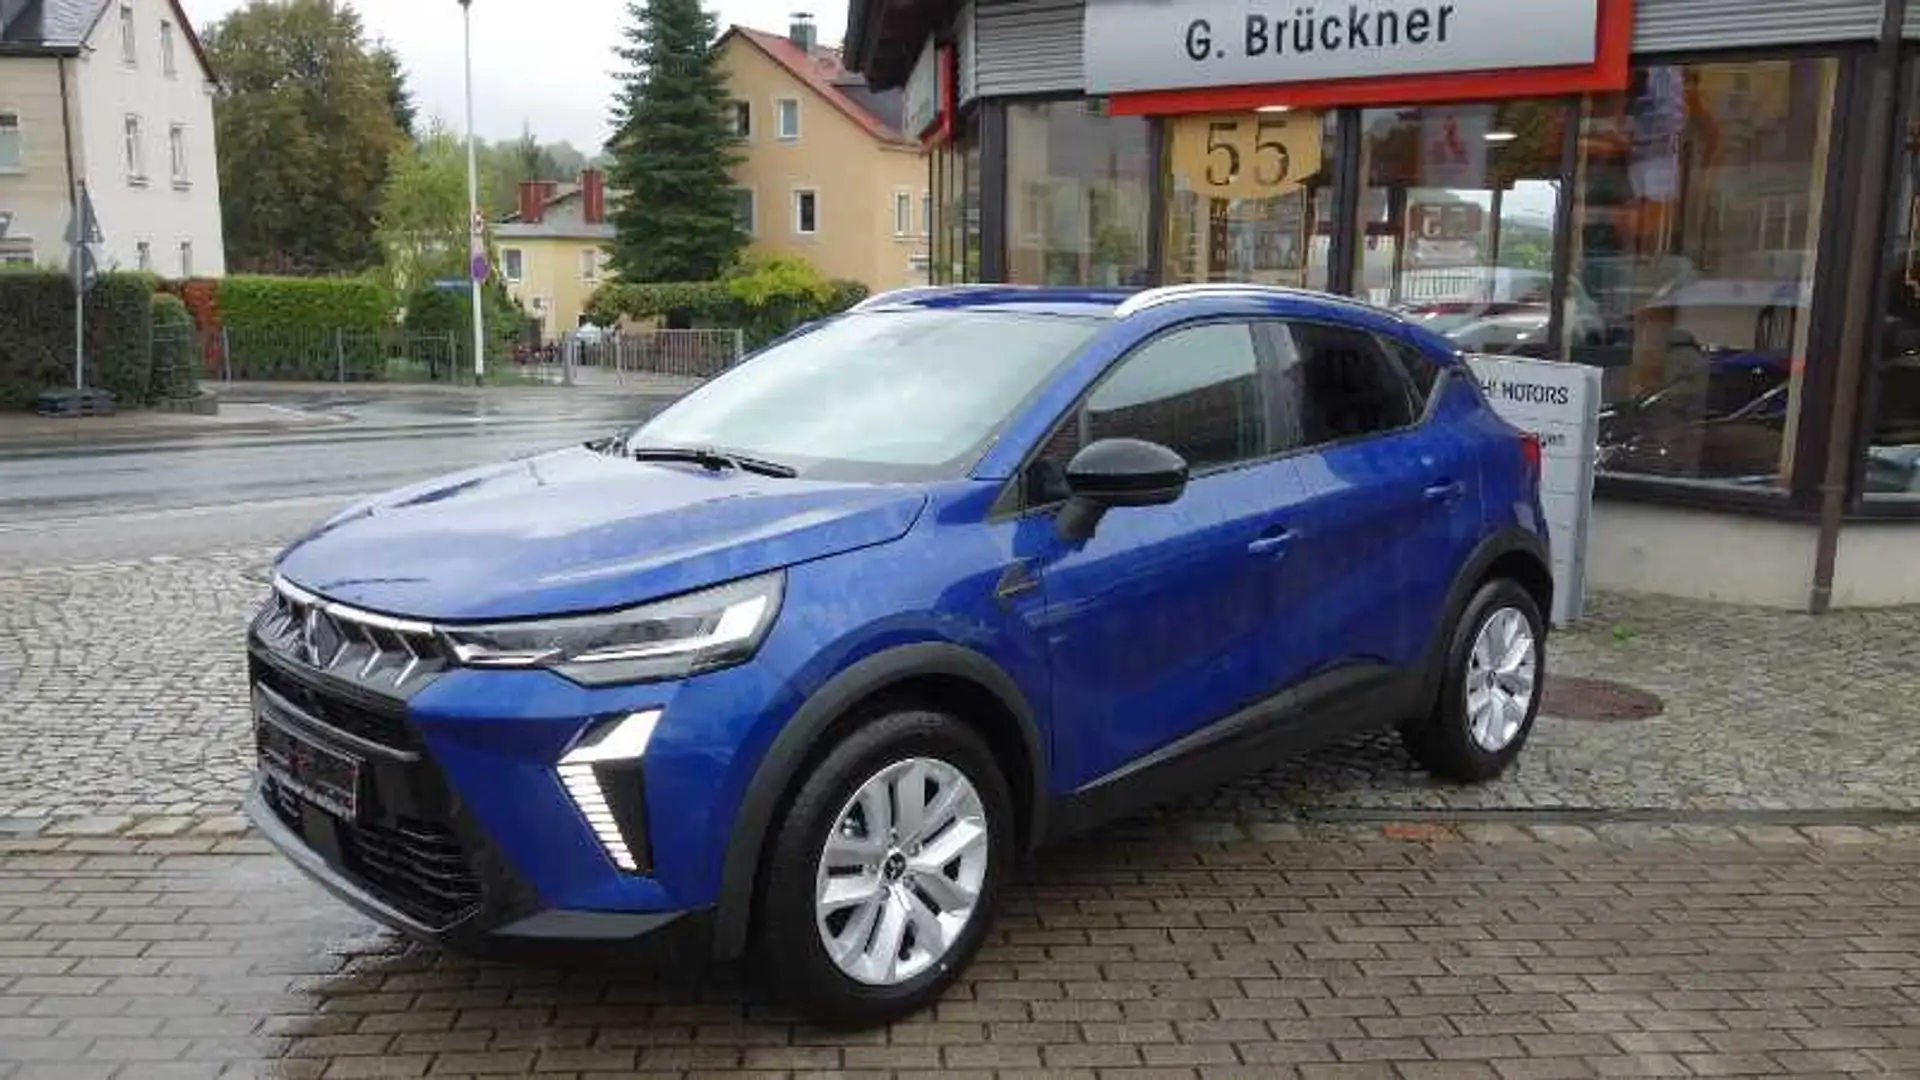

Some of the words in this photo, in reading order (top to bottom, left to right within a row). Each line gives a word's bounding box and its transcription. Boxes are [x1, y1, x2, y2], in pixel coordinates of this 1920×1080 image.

[1185, 18, 1225, 62] G.
[1245, 4, 1454, 58] Brückner
[1205, 120, 1290, 187] 55
[1501, 381, 1569, 404] MOTORS
